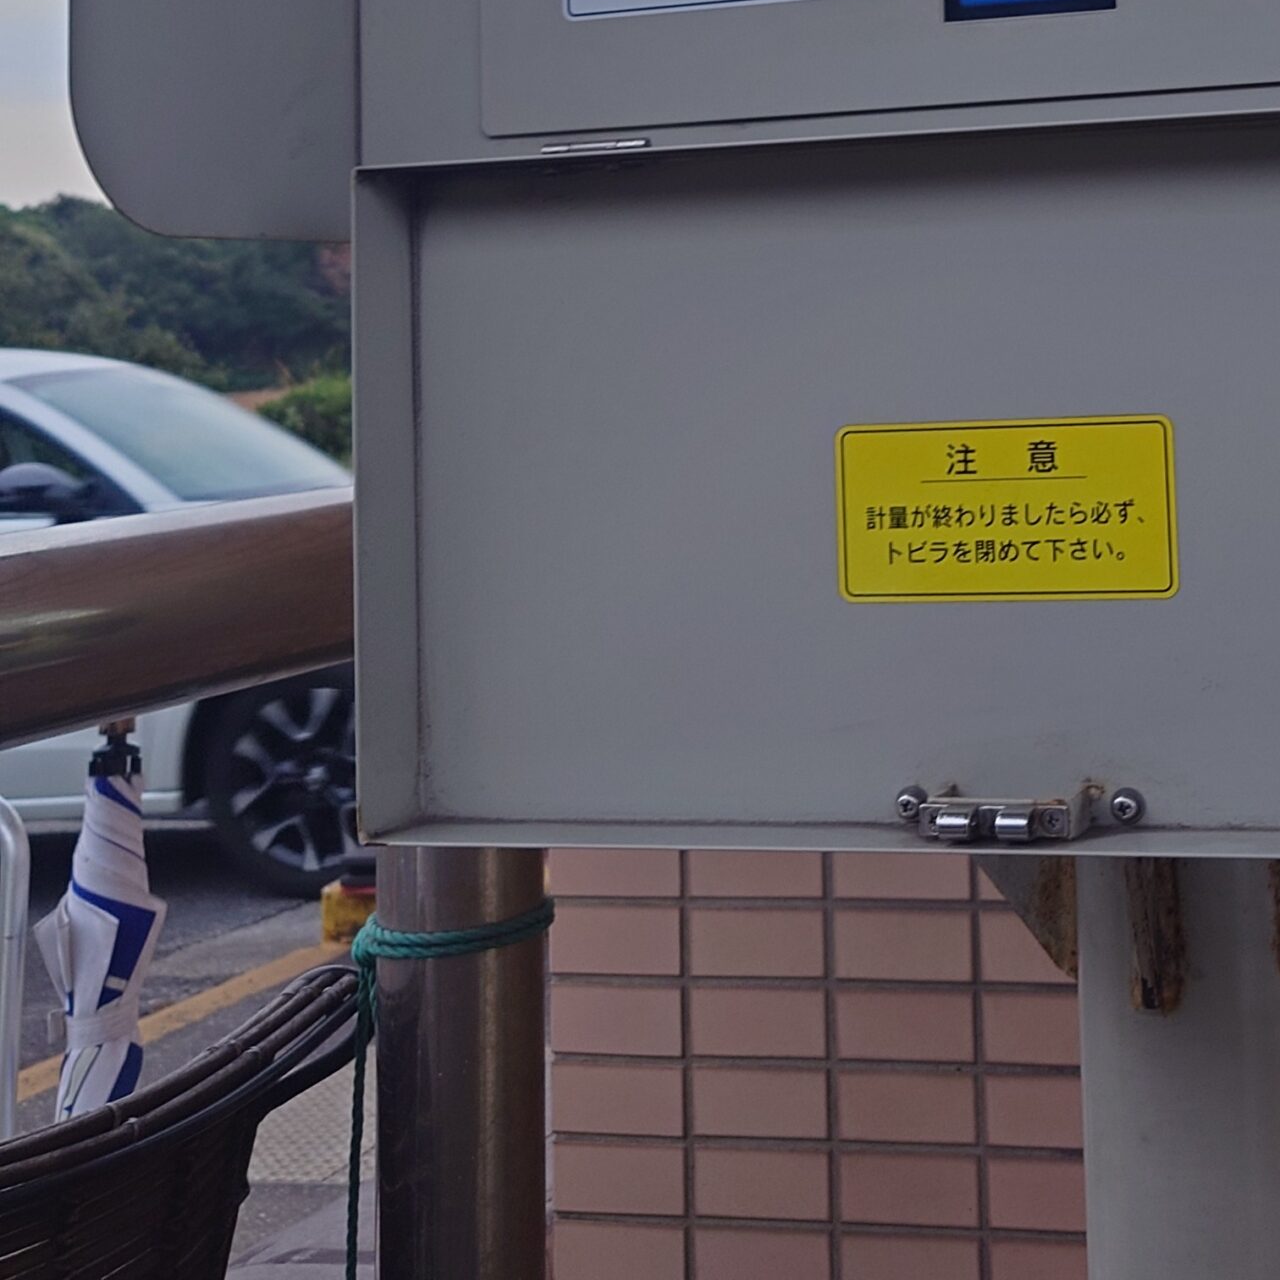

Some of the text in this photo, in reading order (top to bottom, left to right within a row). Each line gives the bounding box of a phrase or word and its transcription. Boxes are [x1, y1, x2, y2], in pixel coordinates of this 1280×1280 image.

[865, 498, 1147, 531] 計量が終わりましたら必ず、
[888, 537, 1127, 565] トビラを閉めて下さい。
